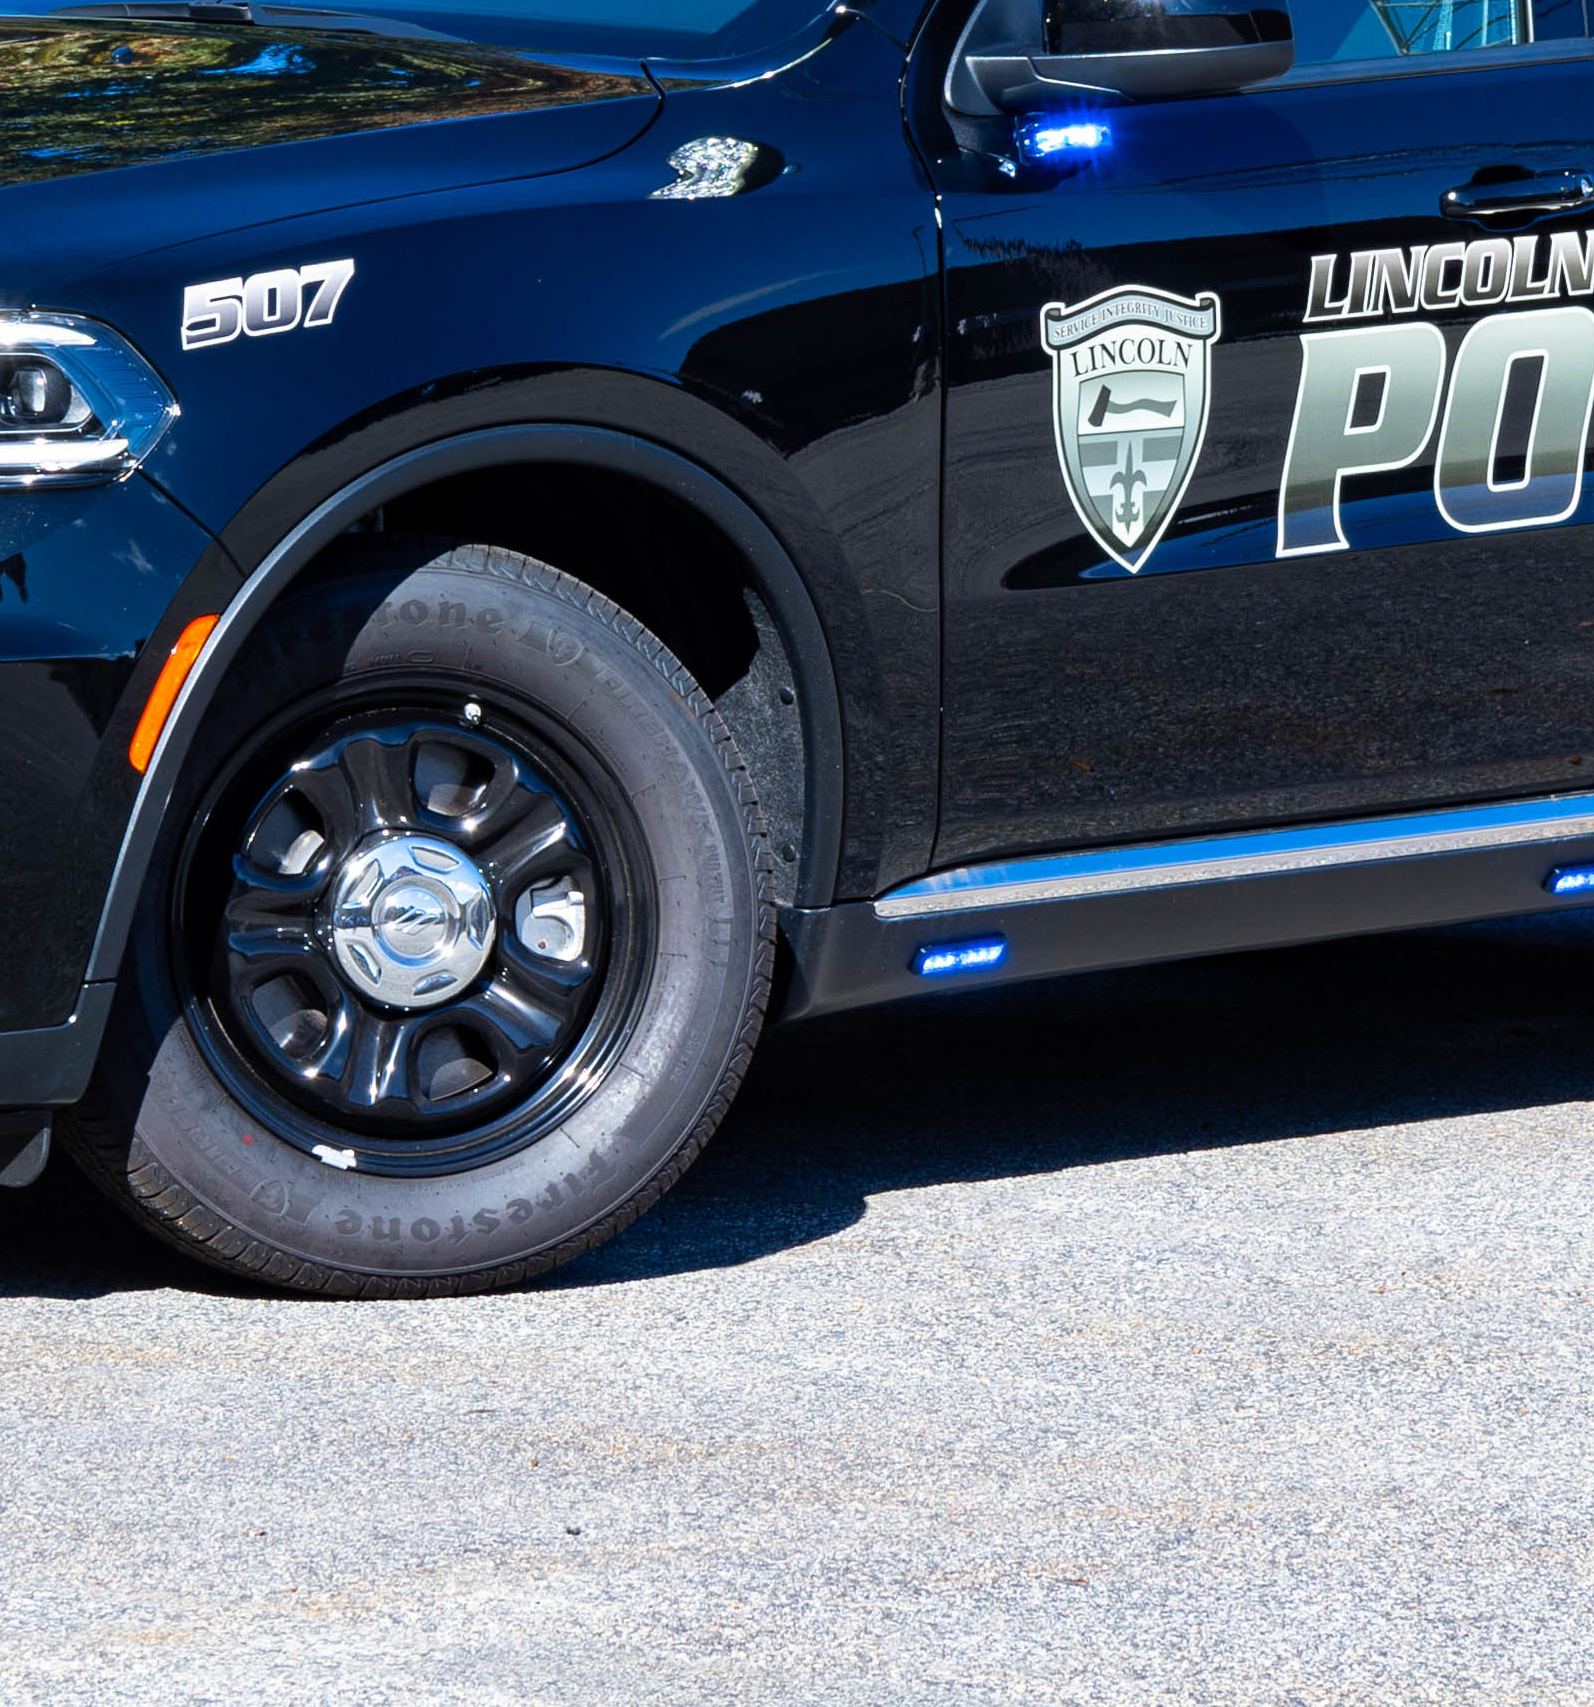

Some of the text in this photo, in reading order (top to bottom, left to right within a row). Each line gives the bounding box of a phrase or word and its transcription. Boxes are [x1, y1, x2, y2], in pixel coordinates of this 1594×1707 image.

[180, 258, 355, 351] 507
[1054, 301, 1208, 340] SERVICE INTEGRITY JUSTICE
[1070, 337, 1193, 377] LINCOLN
